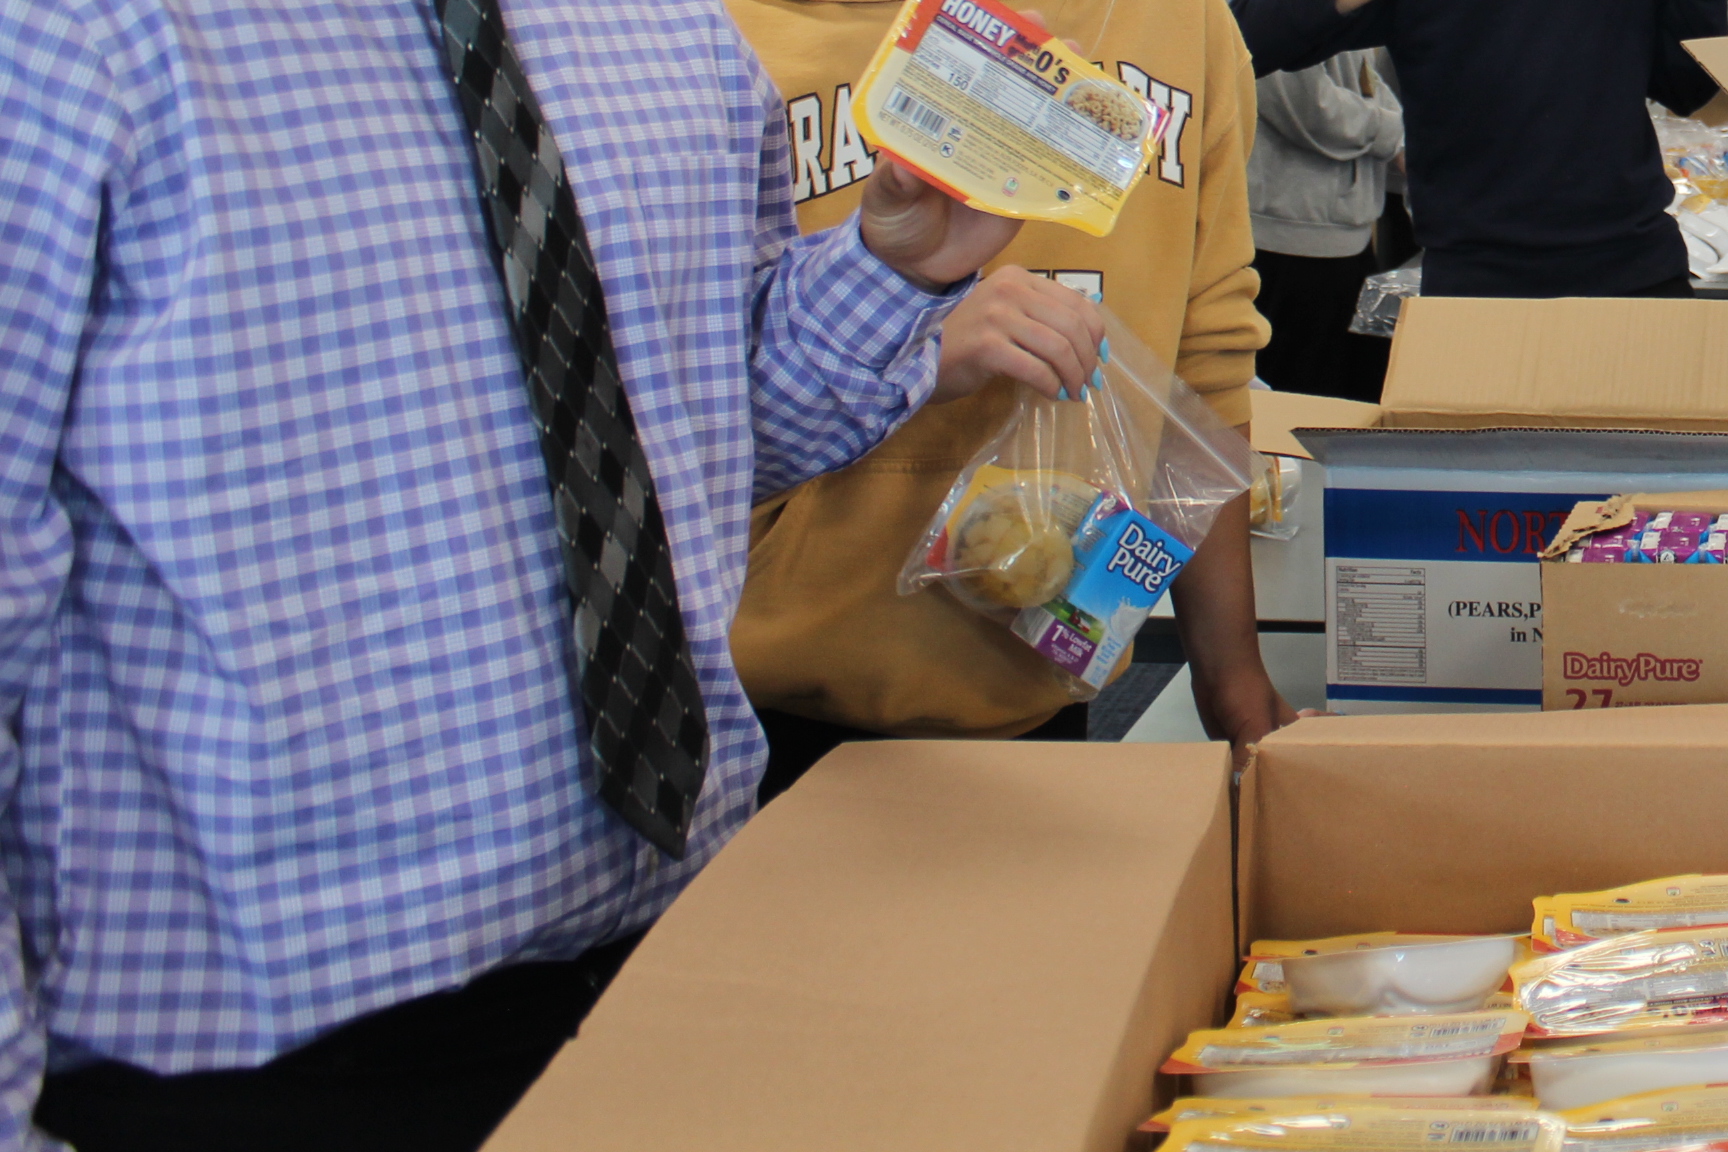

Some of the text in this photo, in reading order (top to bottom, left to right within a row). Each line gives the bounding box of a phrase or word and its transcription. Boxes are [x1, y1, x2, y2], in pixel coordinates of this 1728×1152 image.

[948, 73, 968, 90] 150
[1117, 521, 1183, 577] Dairy
[1106, 548, 1162, 593] Pure
[1068, 633, 1092, 653] Lowfat
[1510, 628, 1527, 642] in
[1069, 642, 1084, 657] Milk
[1564, 652, 1700, 687] DairyPure
